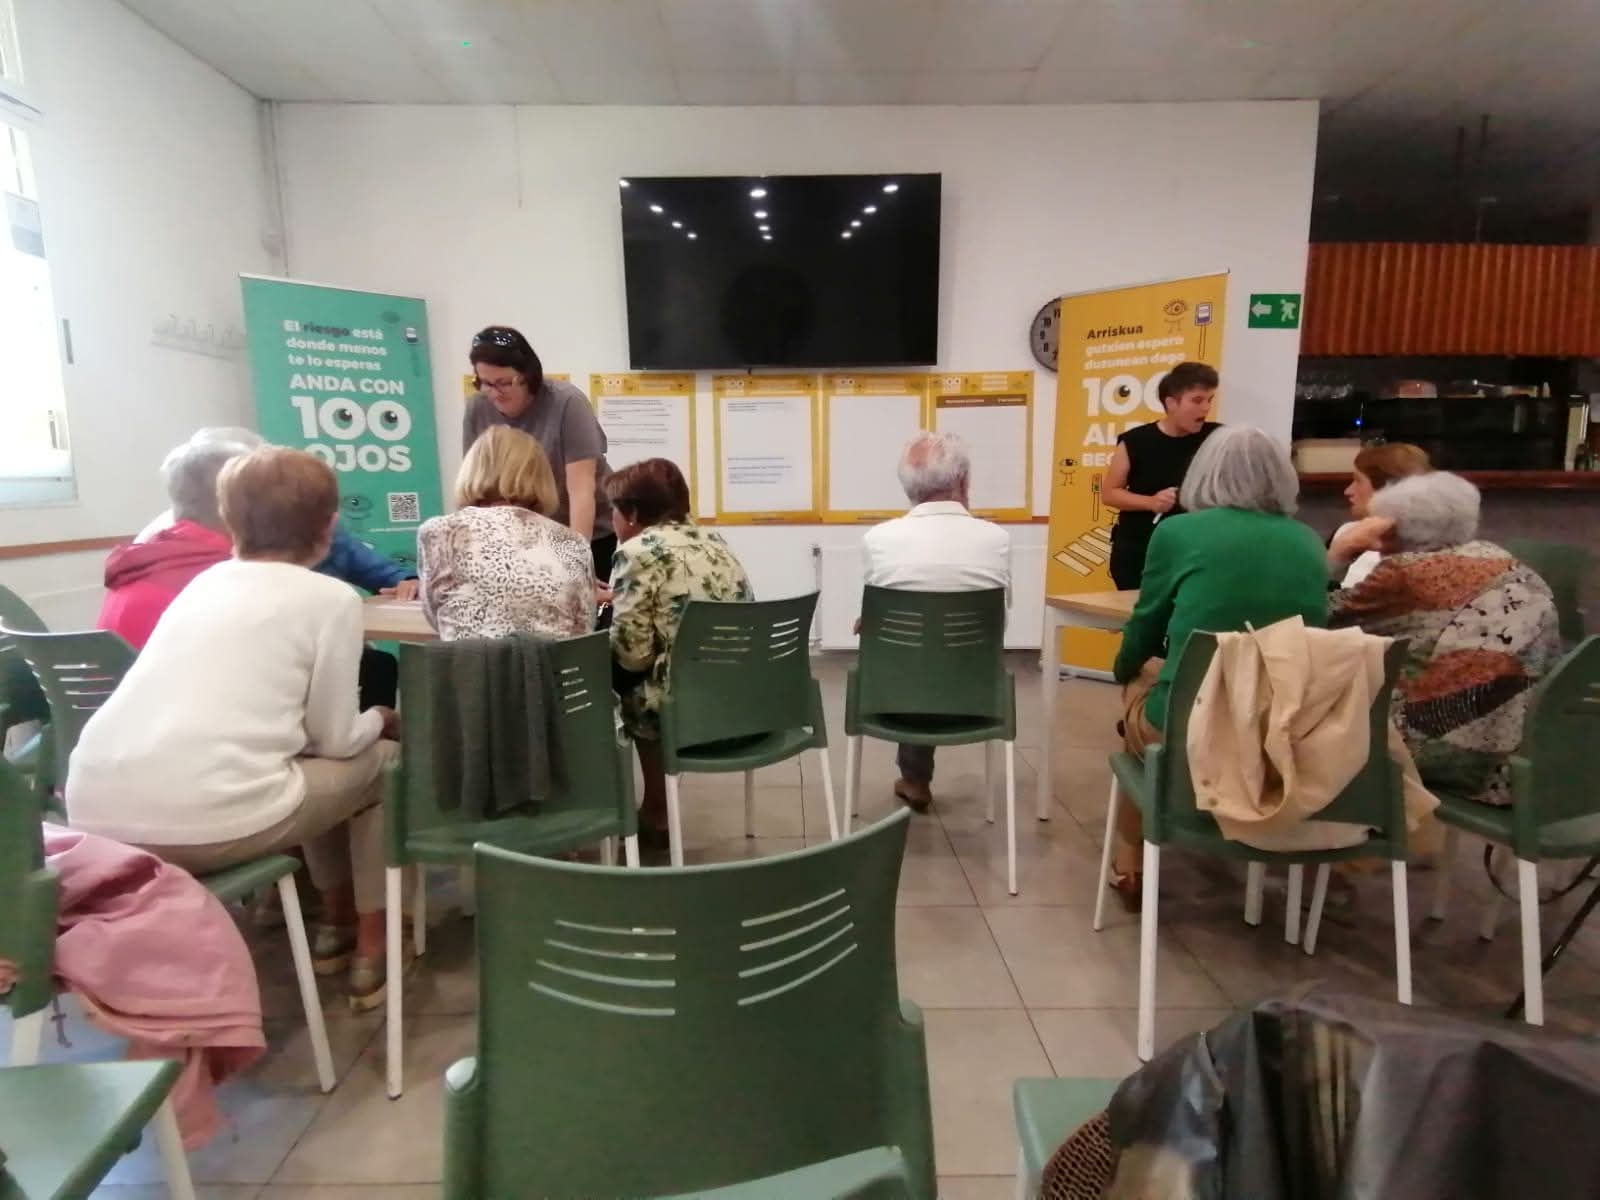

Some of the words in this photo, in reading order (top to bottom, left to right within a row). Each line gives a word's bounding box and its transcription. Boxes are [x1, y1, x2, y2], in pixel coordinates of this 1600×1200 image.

[283, 319, 300, 332] El
[303, 321, 350, 338] riesgo
[352, 327, 384, 340] está
[1086, 324, 1144, 340] Arriskua
[286, 337, 336, 352] donde
[338, 343, 387, 356] menos
[1086, 341, 1136, 358] gutxien
[288, 354, 305, 366] te
[307, 355, 322, 367] lo
[325, 359, 382, 371] esperas
[1085, 355, 1149, 370] duzunean
[290, 374, 357, 393] ANDA
[359, 378, 405, 396] CON
[290, 396, 412, 441] 100
[304, 443, 412, 472] OJOS
